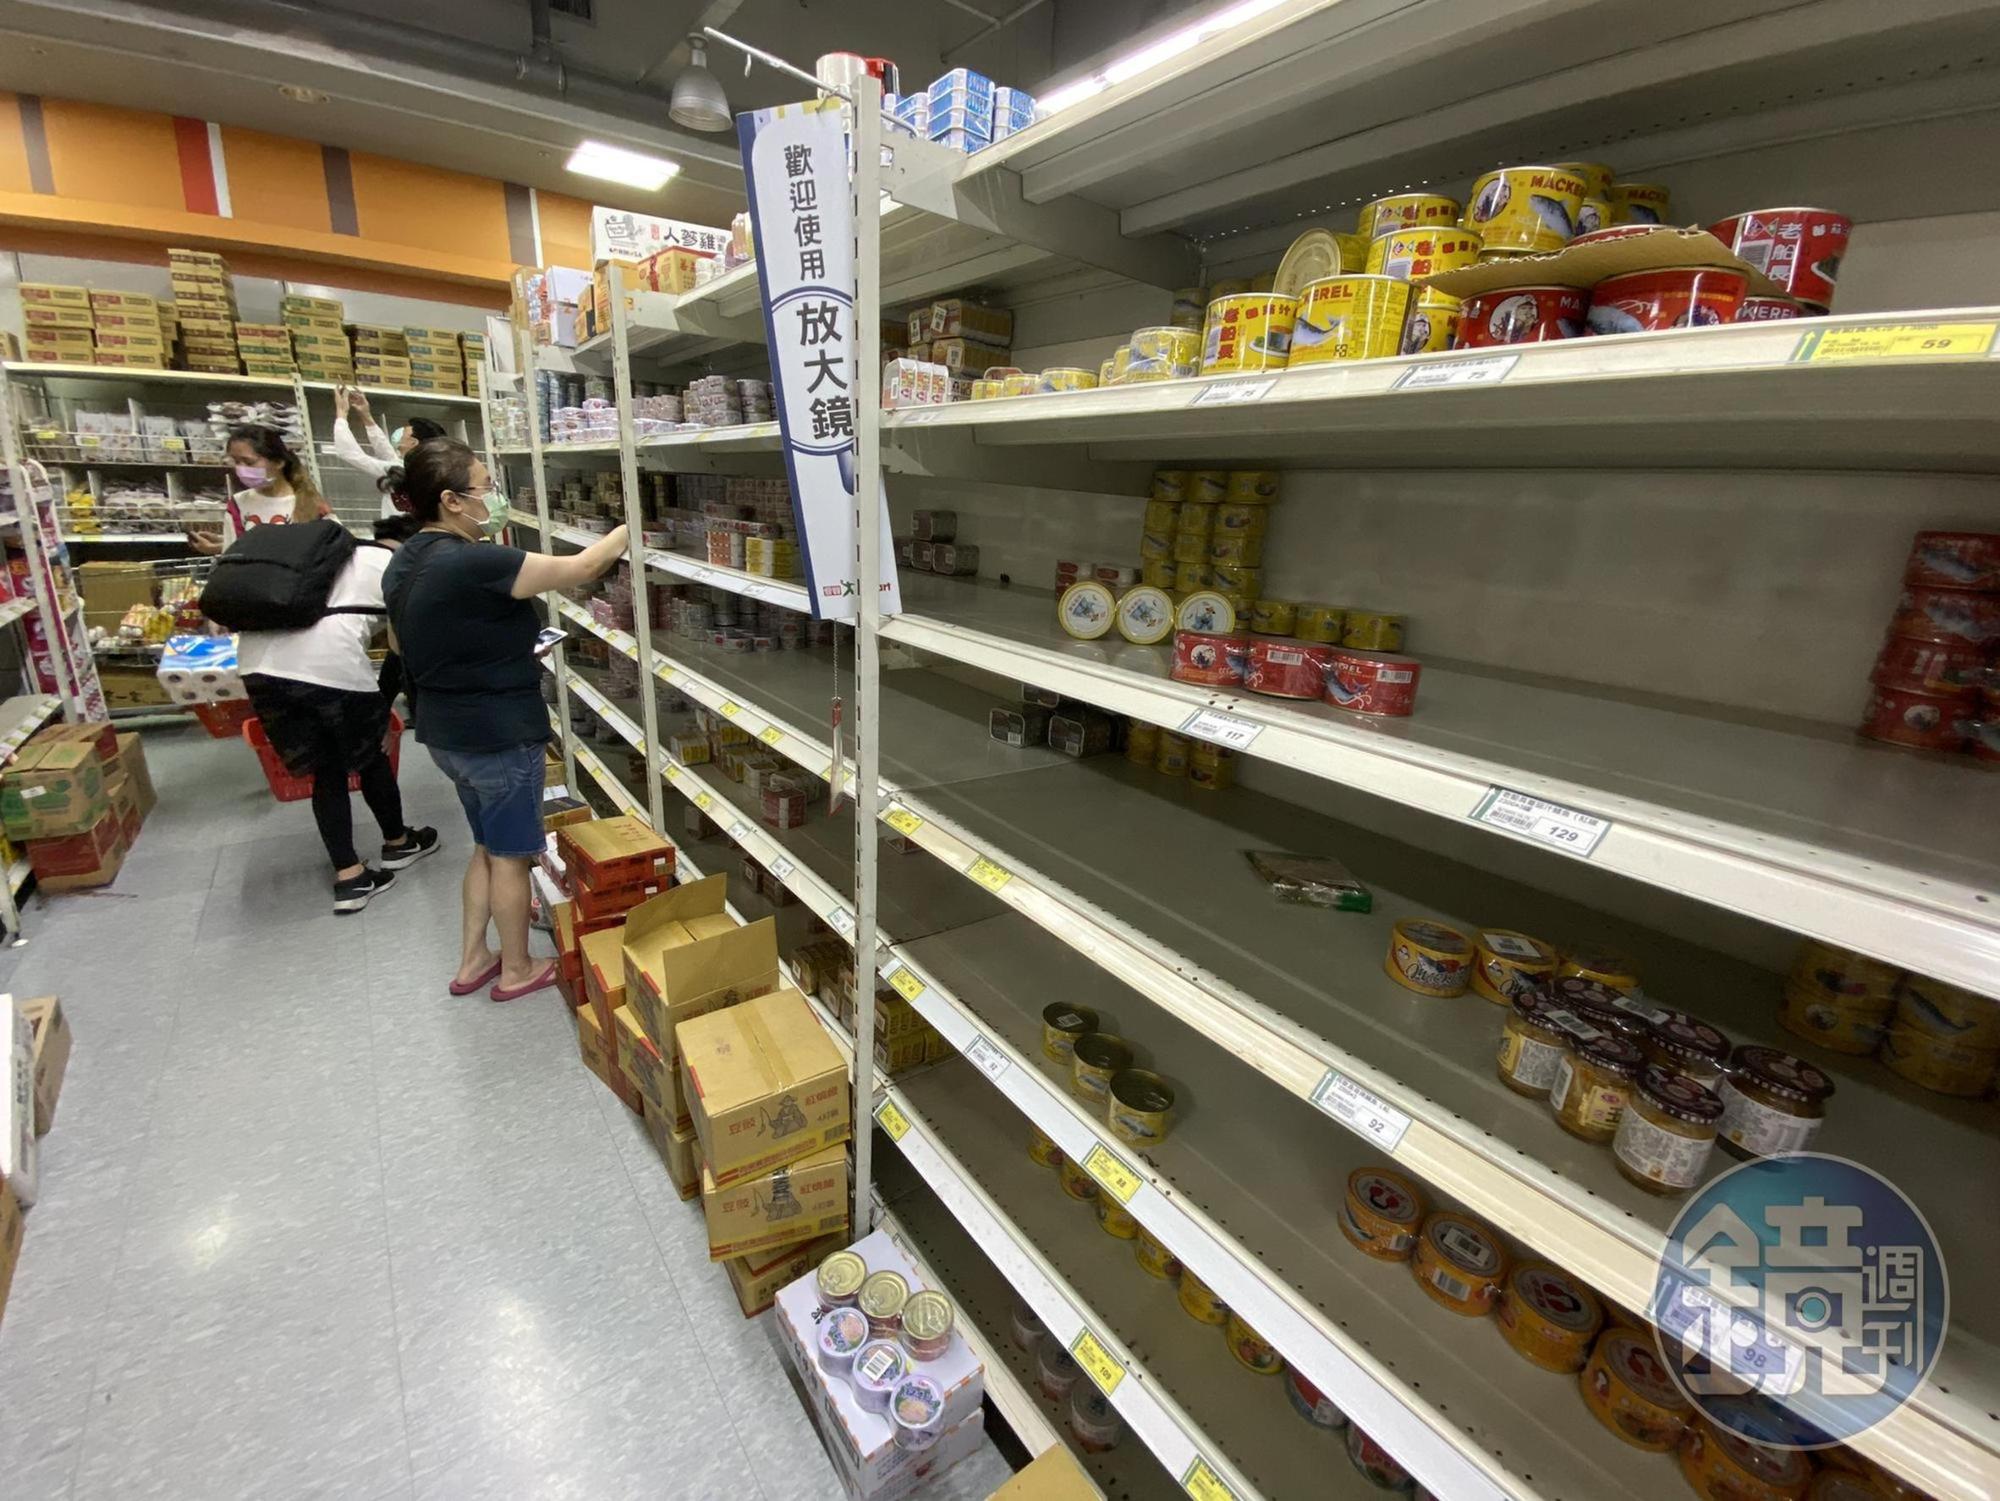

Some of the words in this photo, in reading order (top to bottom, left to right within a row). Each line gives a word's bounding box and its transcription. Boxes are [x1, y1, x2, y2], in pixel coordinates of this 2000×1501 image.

[784, 144, 825, 281] 歡迎使用
[1768, 223, 1803, 281] 老船長
[1920, 339, 1953, 350] 59
[796, 301, 854, 440] 放大鏡
[1225, 731, 1245, 741] 117
[1549, 826, 1579, 842] 129
[1368, 1118, 1385, 1133] 92
[1743, 1348, 1767, 1368] 98
